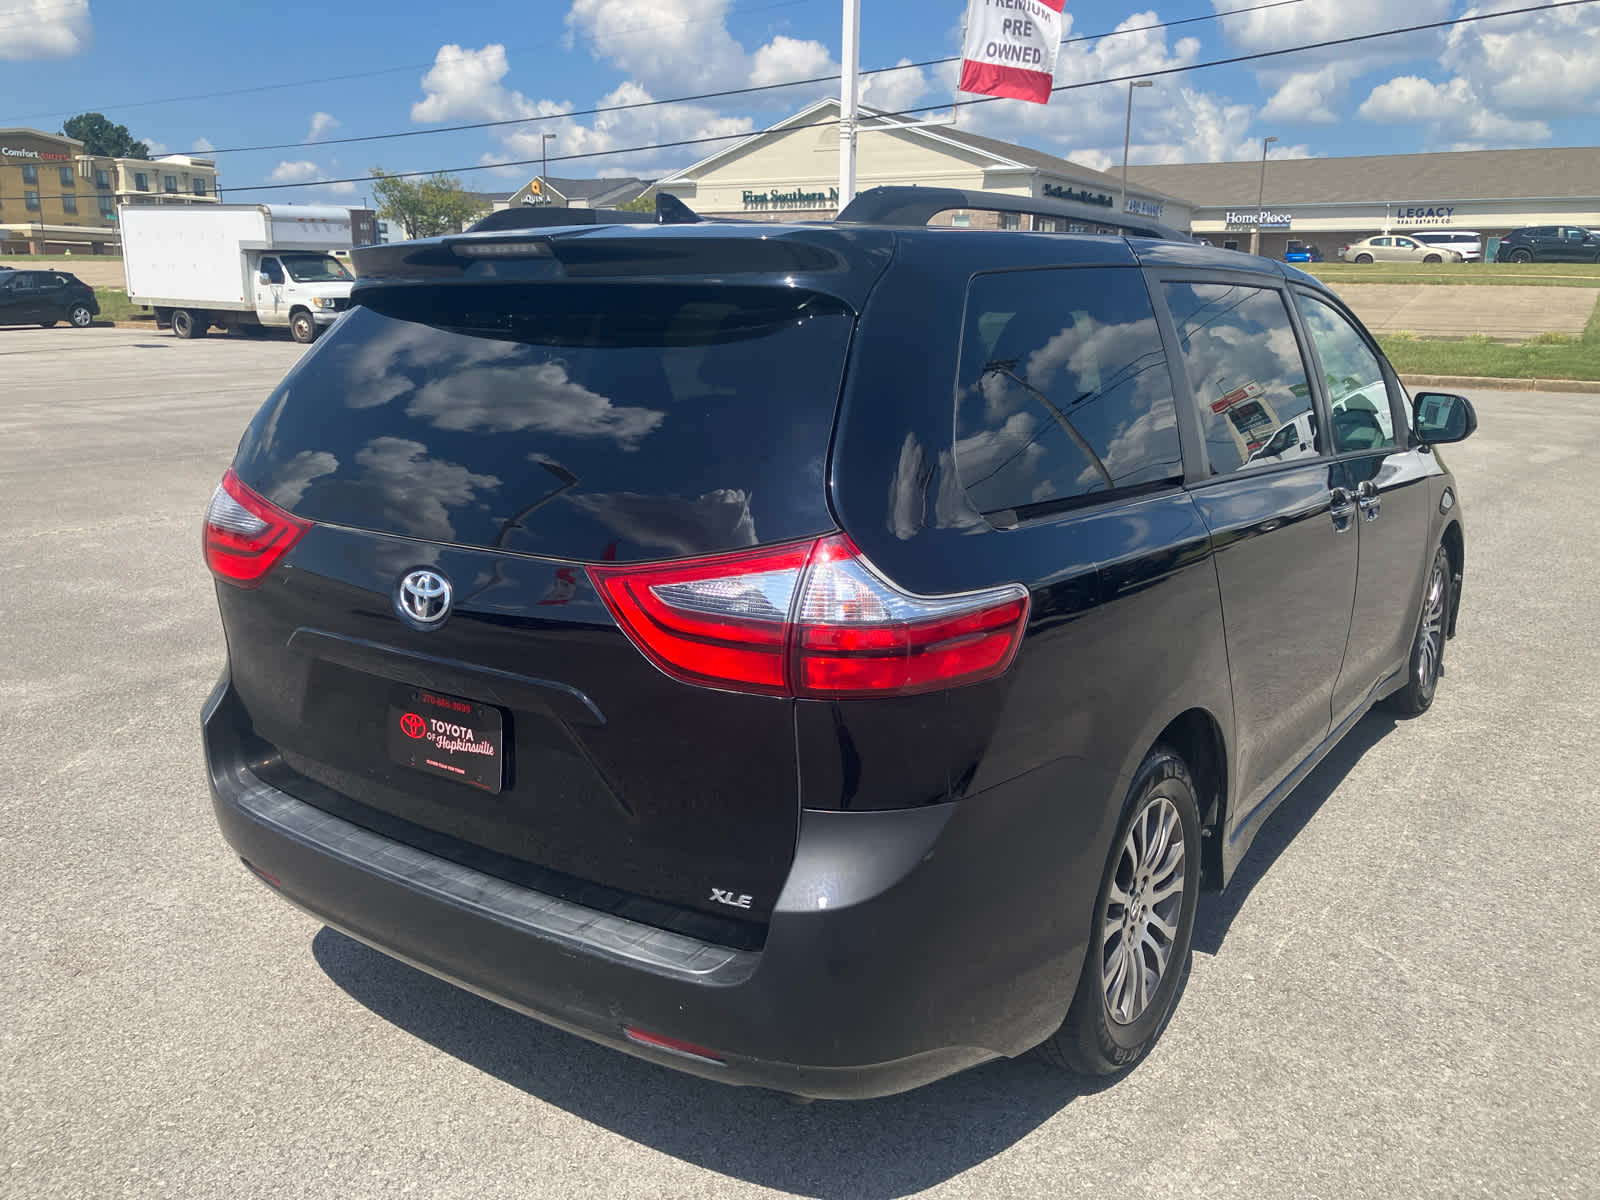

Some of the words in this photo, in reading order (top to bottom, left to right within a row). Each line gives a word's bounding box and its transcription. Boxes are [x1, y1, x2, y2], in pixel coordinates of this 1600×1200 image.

[1002, 18, 1032, 37] PRE
[986, 41, 1041, 64] OWNED
[1, 147, 39, 159] Comfort
[741, 190, 768, 203] First
[770, 188, 825, 202] Southern
[1397, 207, 1454, 218] LEGACY
[430, 718, 474, 741] TOYOTA
[435, 735, 495, 756] Hopkinsville
[709, 888, 753, 909] XLE
